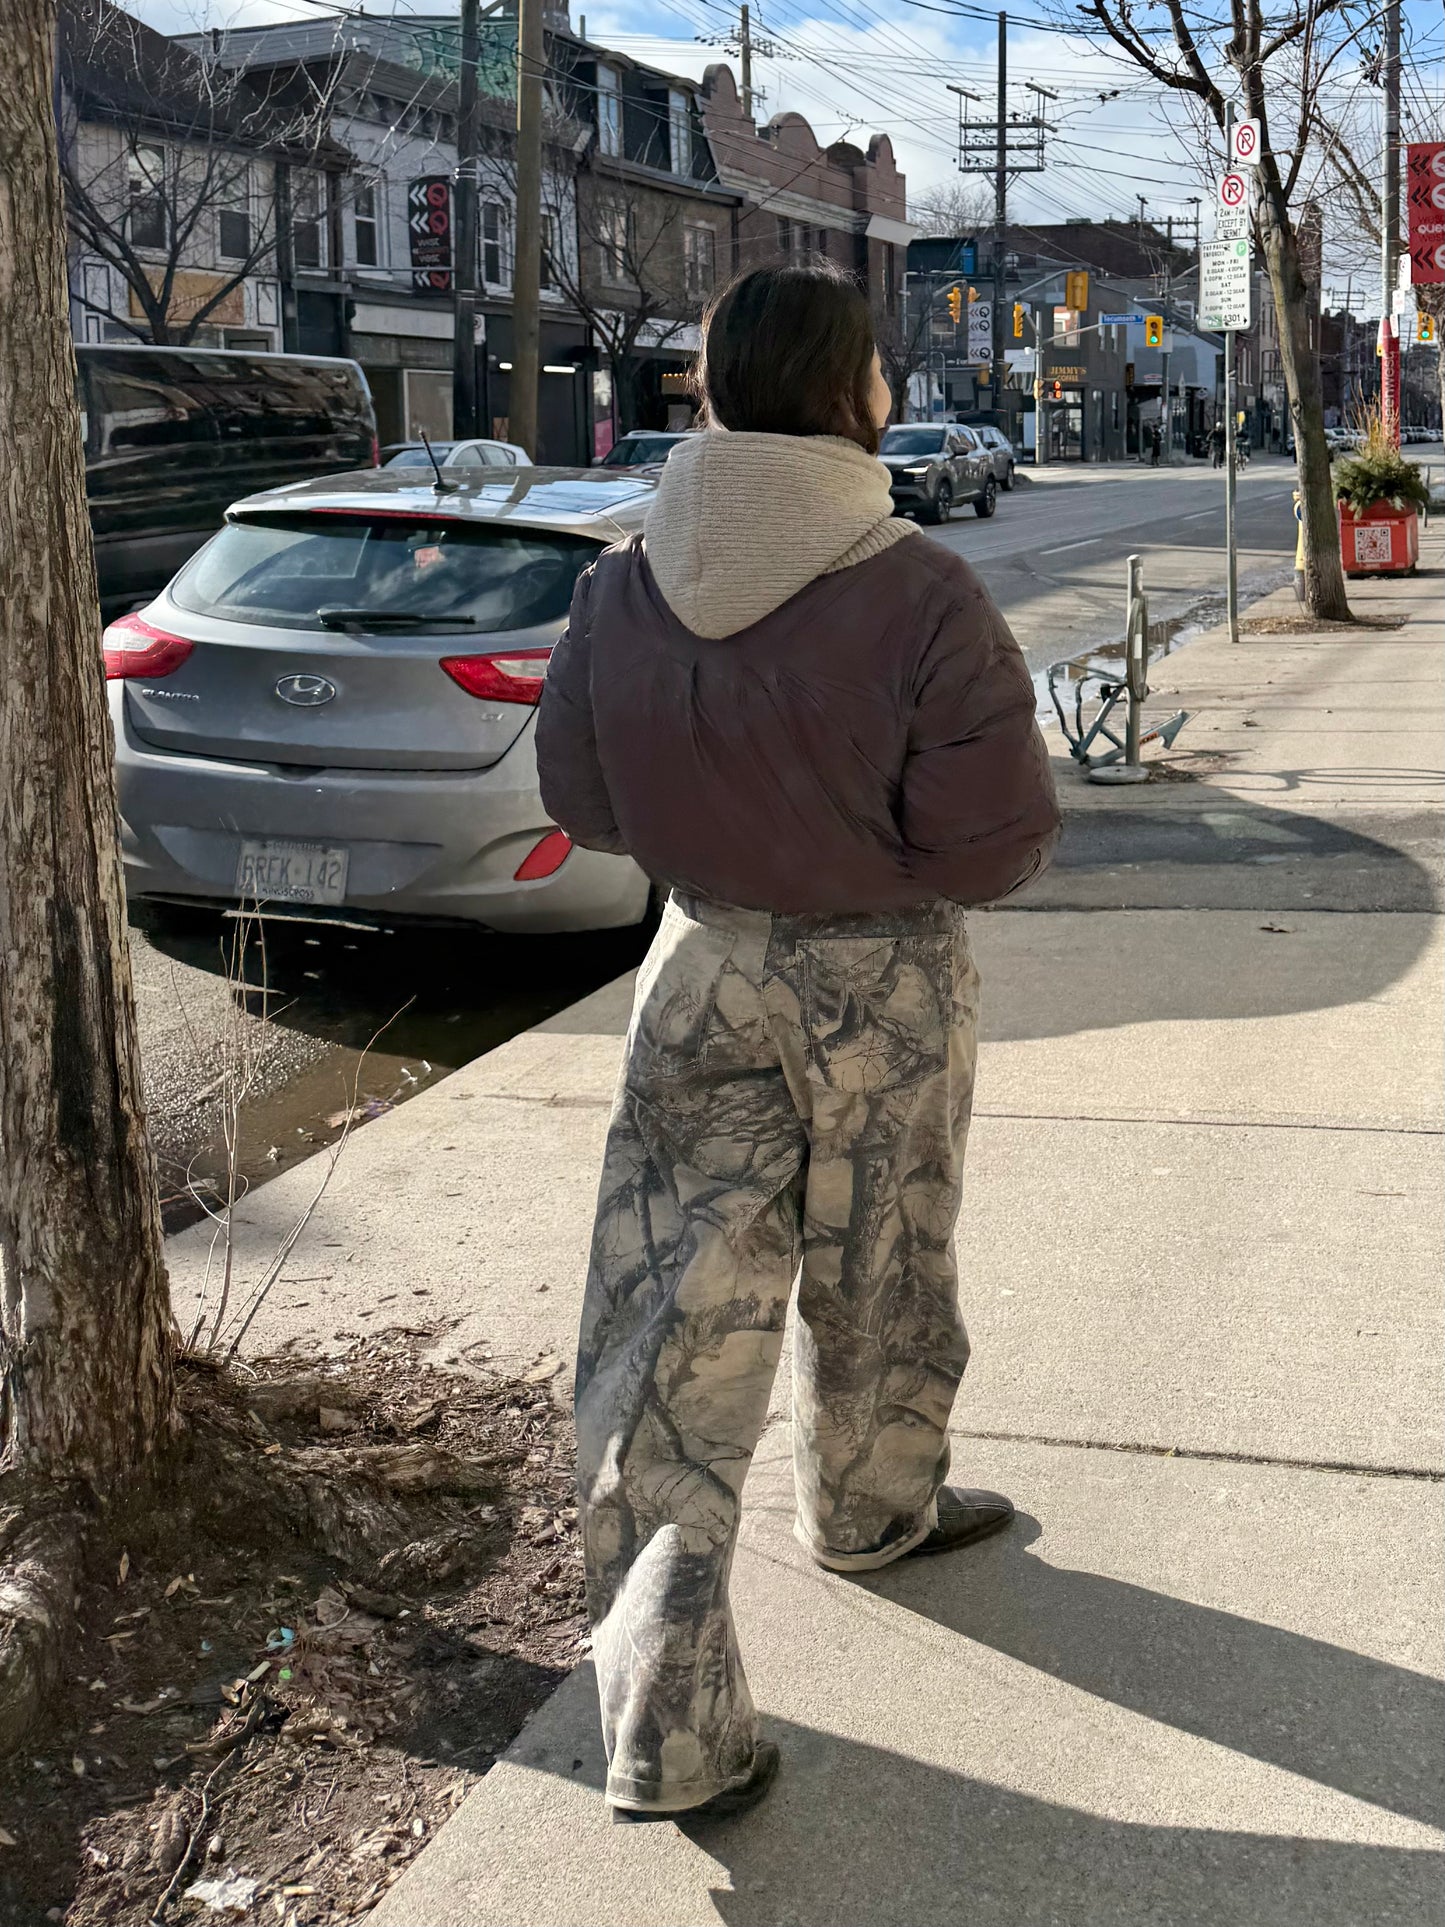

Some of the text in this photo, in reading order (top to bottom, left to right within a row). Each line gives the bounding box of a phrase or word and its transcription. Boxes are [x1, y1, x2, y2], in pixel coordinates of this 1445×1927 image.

[1218, 218, 1246, 228] EXCEPT BY
[1223, 228, 1241, 237] PERMIT
[1050, 366, 1087, 374] JIMMY'S
[308, 860, 341, 890] 142
